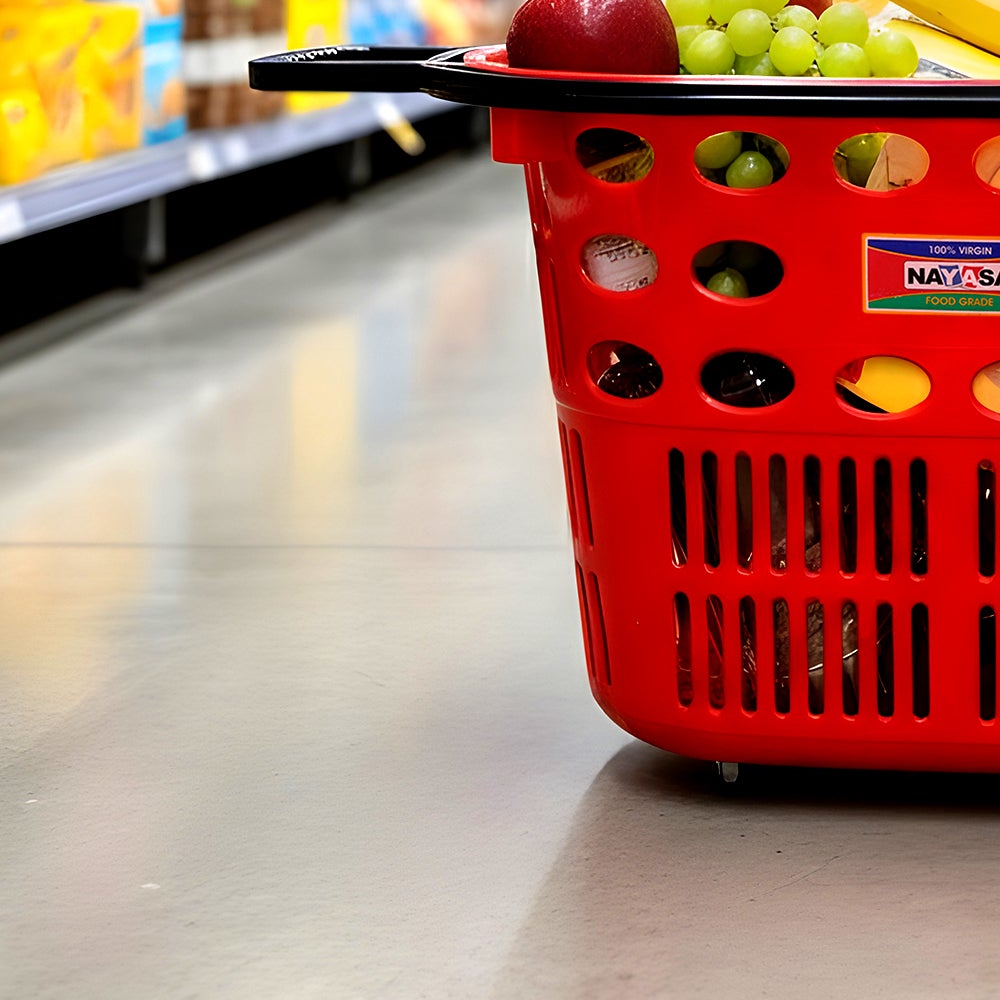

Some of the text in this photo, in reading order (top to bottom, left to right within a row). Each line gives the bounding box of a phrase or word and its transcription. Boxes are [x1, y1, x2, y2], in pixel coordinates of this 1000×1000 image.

[929, 245, 992, 255] 100% VIRGIN
[926, 296, 993, 306] FOOD GRADE
